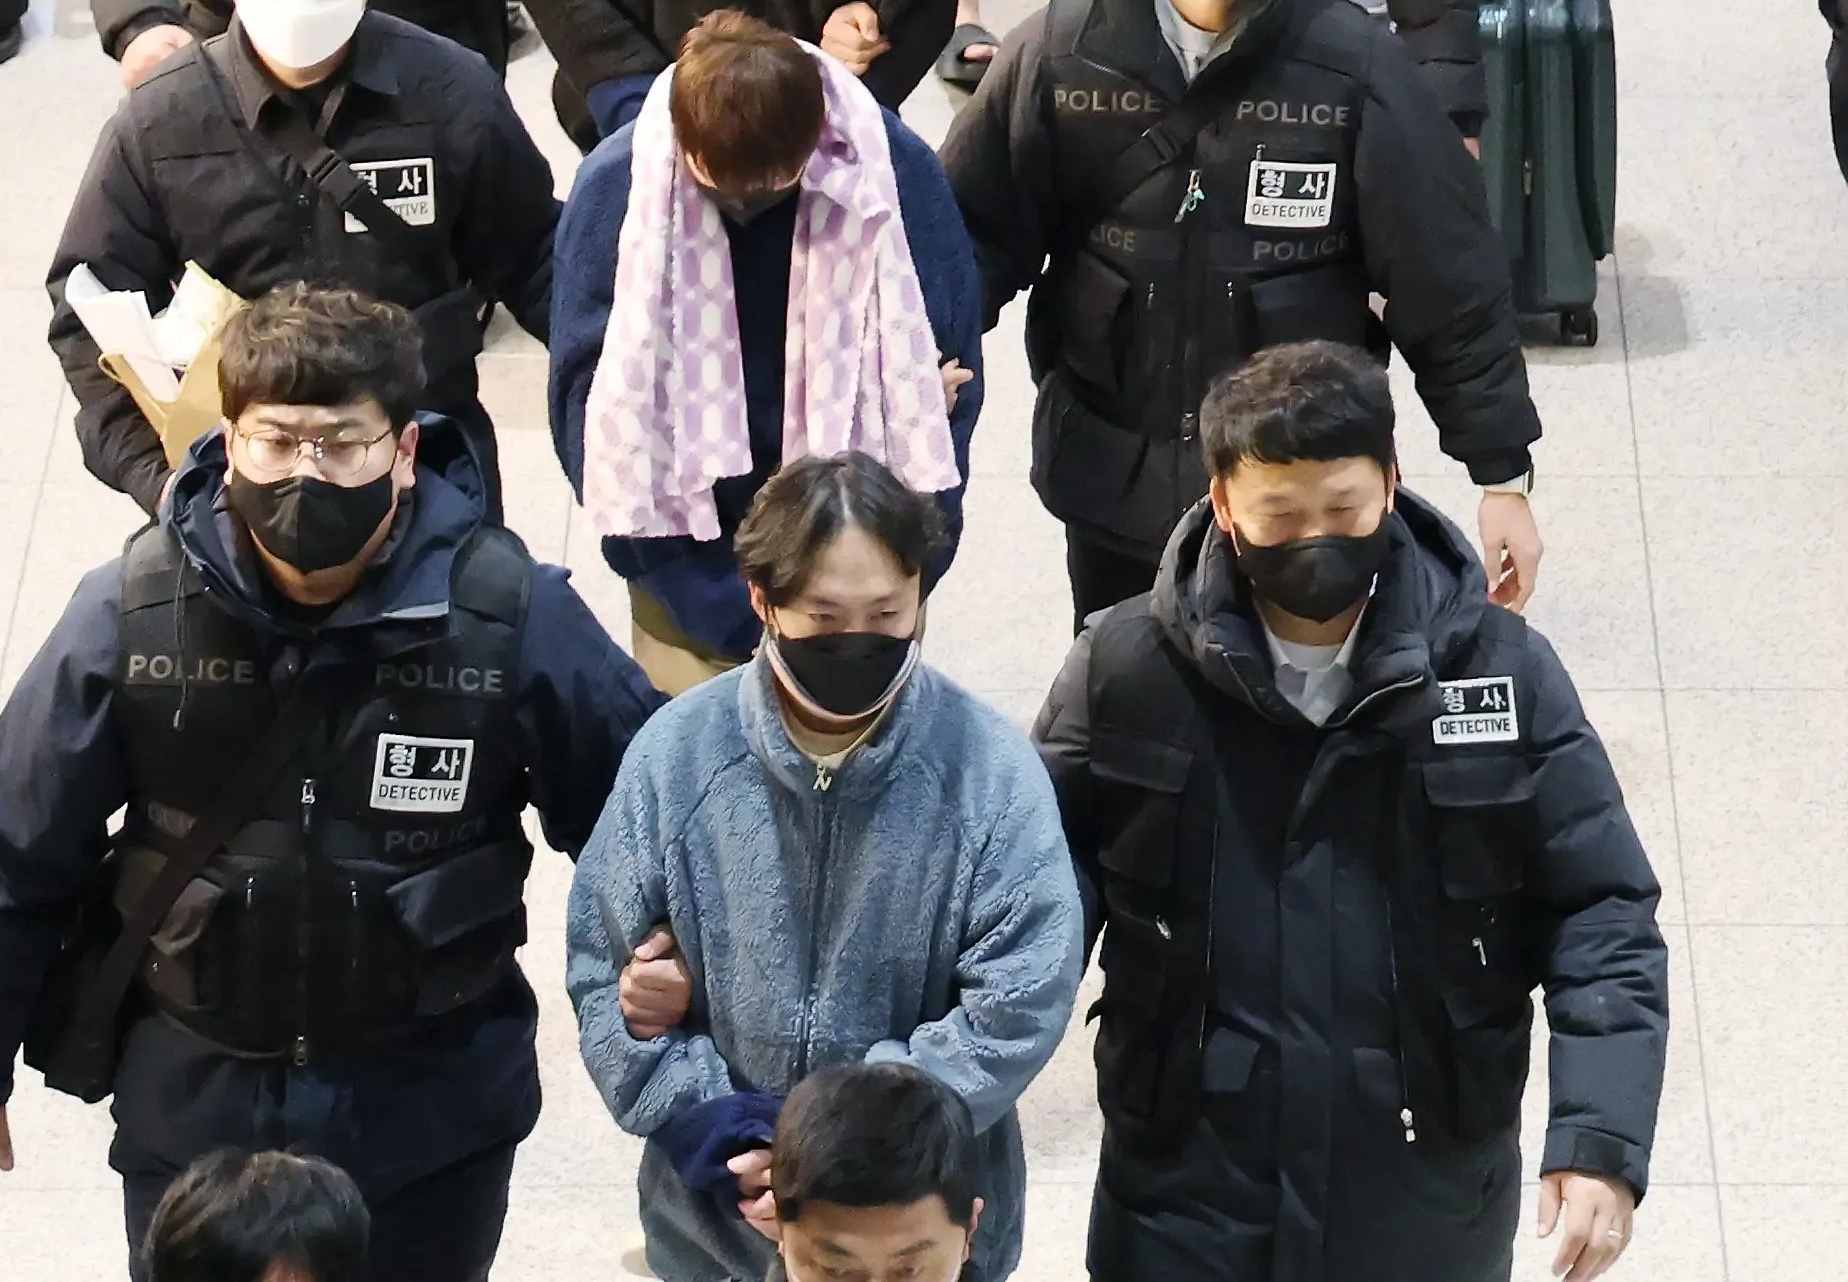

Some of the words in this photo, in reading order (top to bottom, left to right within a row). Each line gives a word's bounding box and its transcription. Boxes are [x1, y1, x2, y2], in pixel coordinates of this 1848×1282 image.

[1054, 89, 1162, 113] POLICE
[1235, 100, 1349, 127] POLICE
[1259, 169, 1326, 199] 형사
[1251, 202, 1326, 218] DETECTIVE
[128, 653, 254, 684] POLICE
[374, 663, 504, 692] POLICE
[1442, 685, 1506, 713] 형사
[1440, 717, 1511, 735] DETECTIVE
[387, 743, 461, 780] 형사
[378, 784, 462, 802] DETECTIVE
